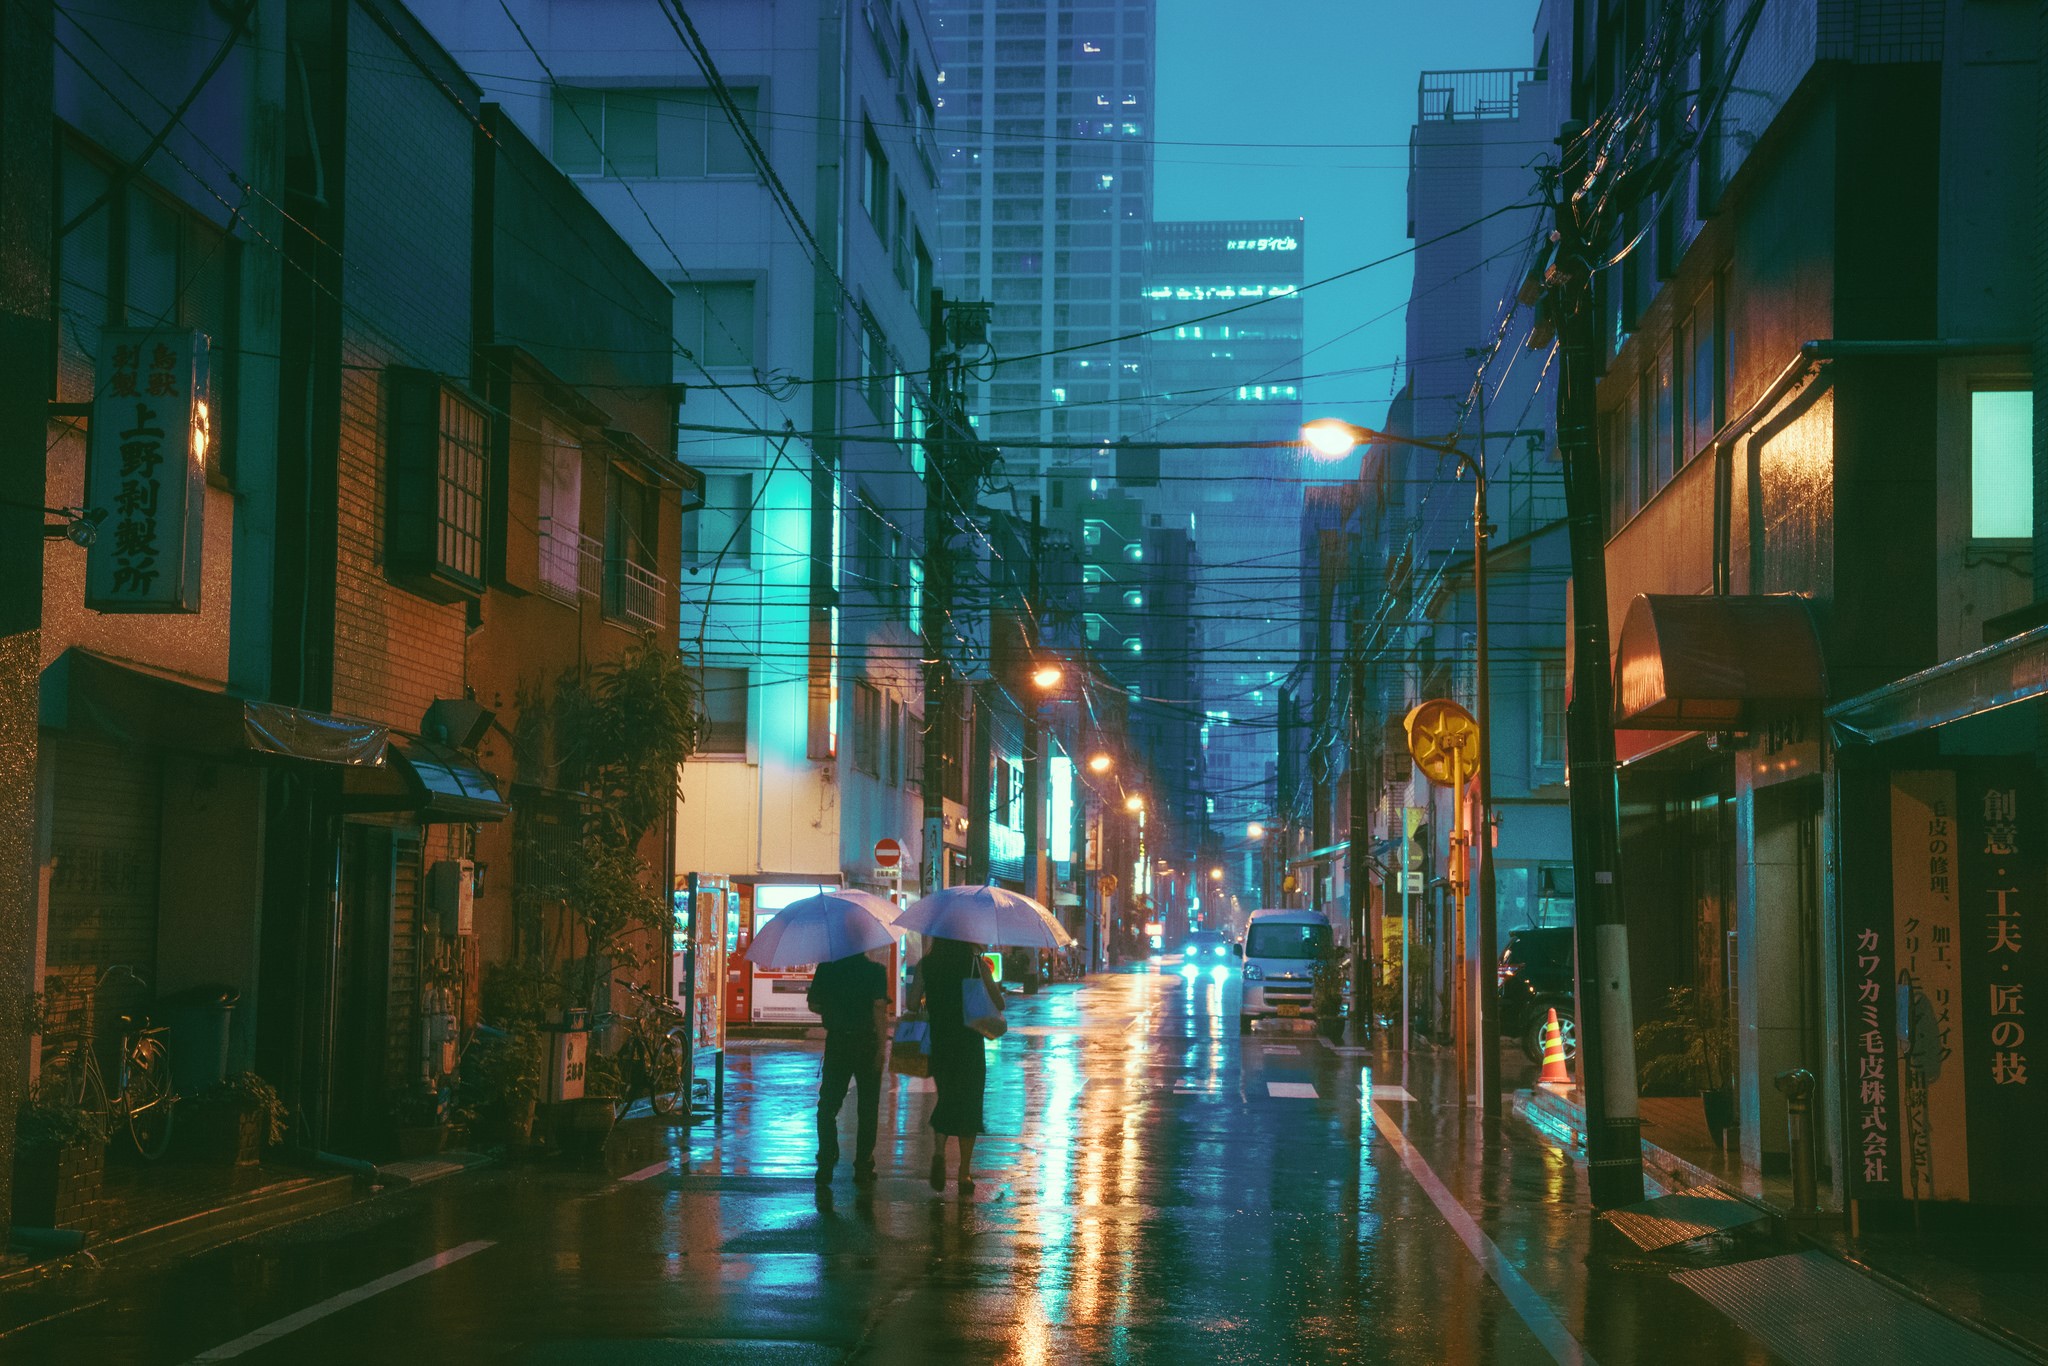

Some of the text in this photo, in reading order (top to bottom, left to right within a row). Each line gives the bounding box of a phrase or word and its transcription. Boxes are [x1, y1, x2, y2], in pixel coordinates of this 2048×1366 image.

[112, 403, 165, 596] 上野剥製所
[1931, 924, 1952, 970] 加工、
[1936, 988, 1953, 1062] リメイク
[1983, 788, 2029, 1085] 創意・工夫・匠の技
[1857, 928, 1890, 1183] カワカミ毛皮株式会社
